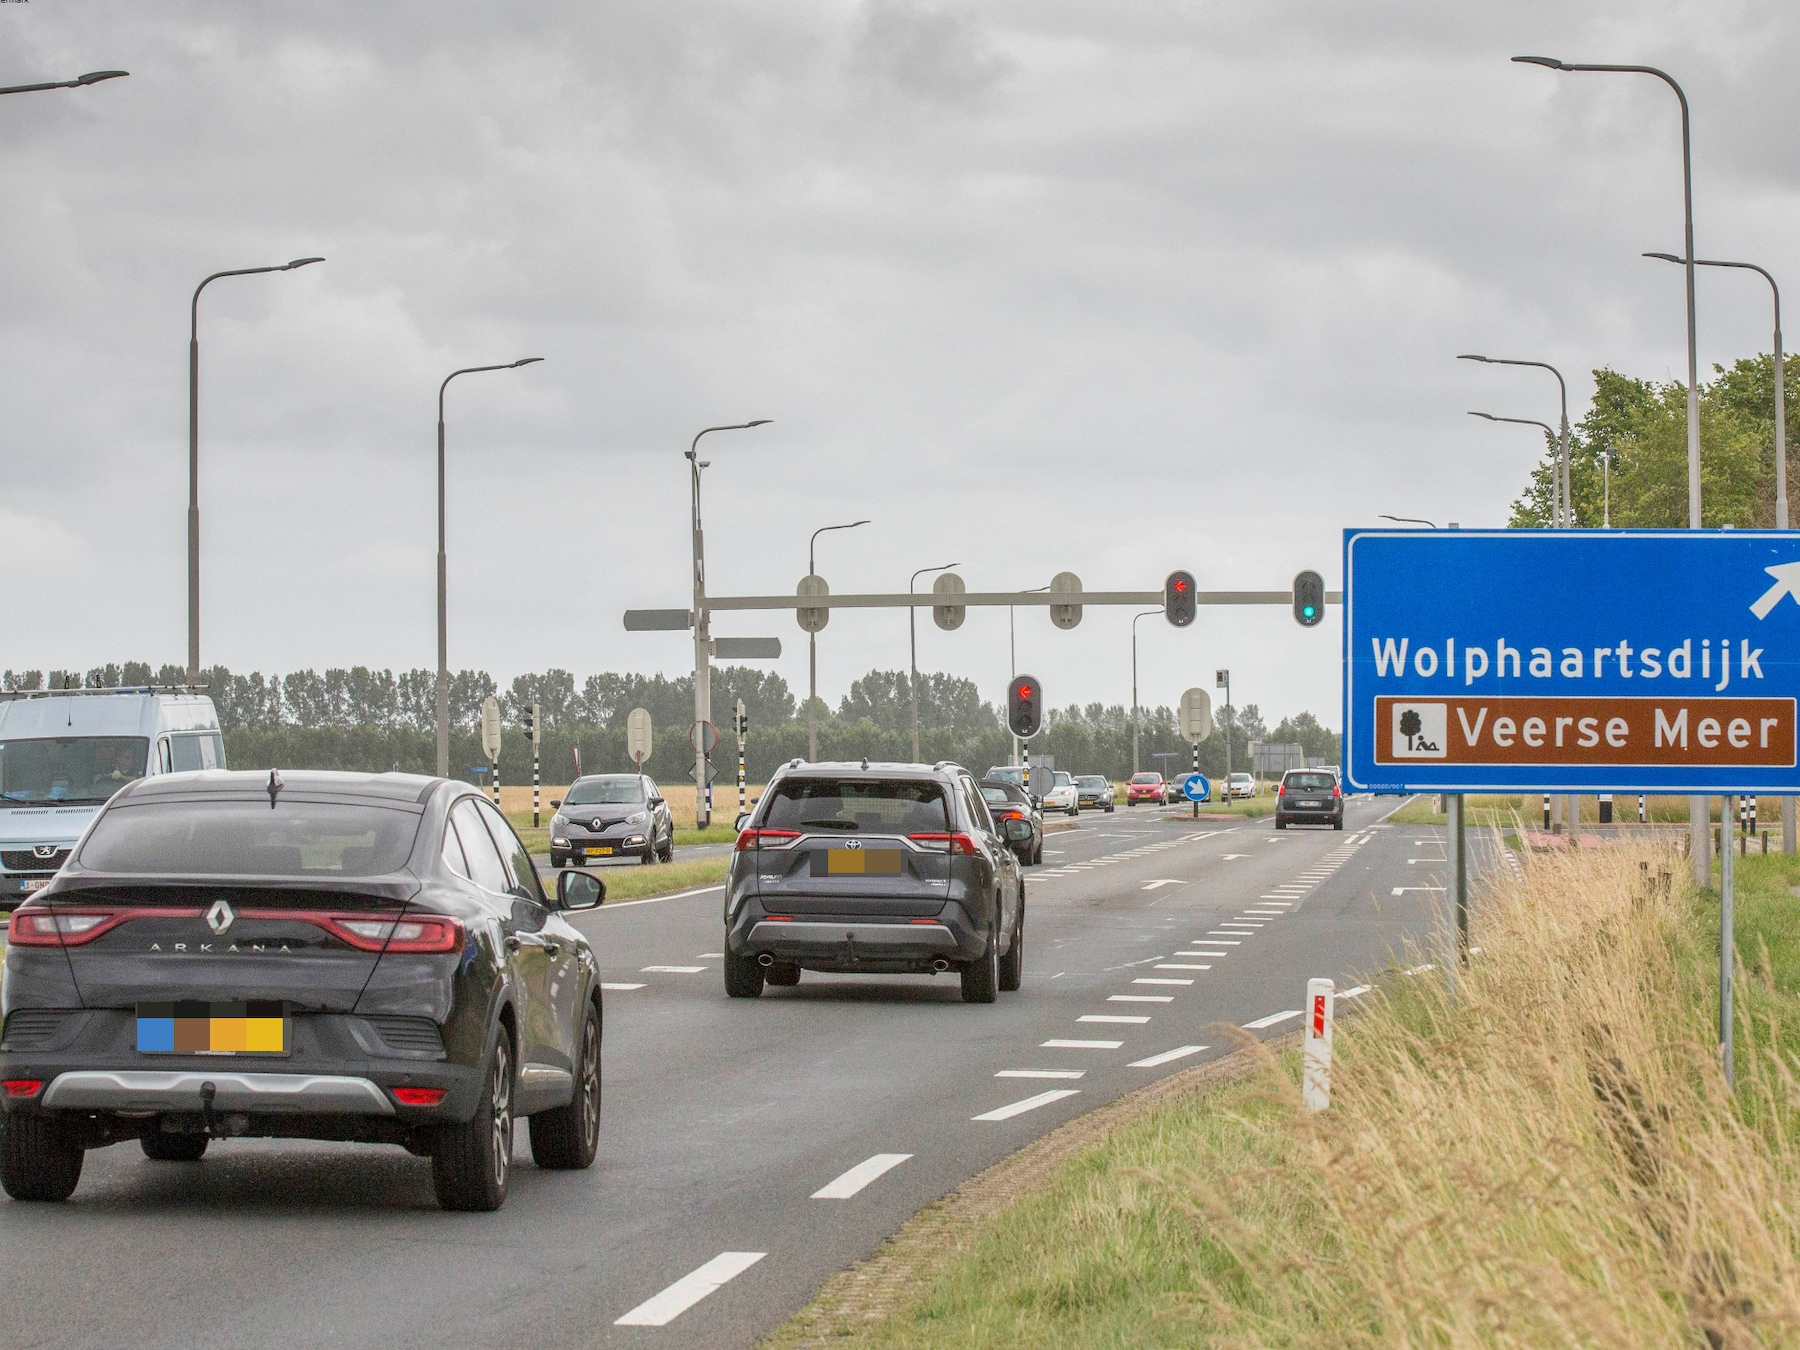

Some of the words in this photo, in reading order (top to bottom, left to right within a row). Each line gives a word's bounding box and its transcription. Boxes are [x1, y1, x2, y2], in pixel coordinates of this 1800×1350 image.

[1372, 637, 1764, 692] Wolphaartsdijk
[1456, 707, 1629, 748] Veerse
[1655, 708, 1778, 748] Meer
[149, 943, 292, 953] ARKANA
